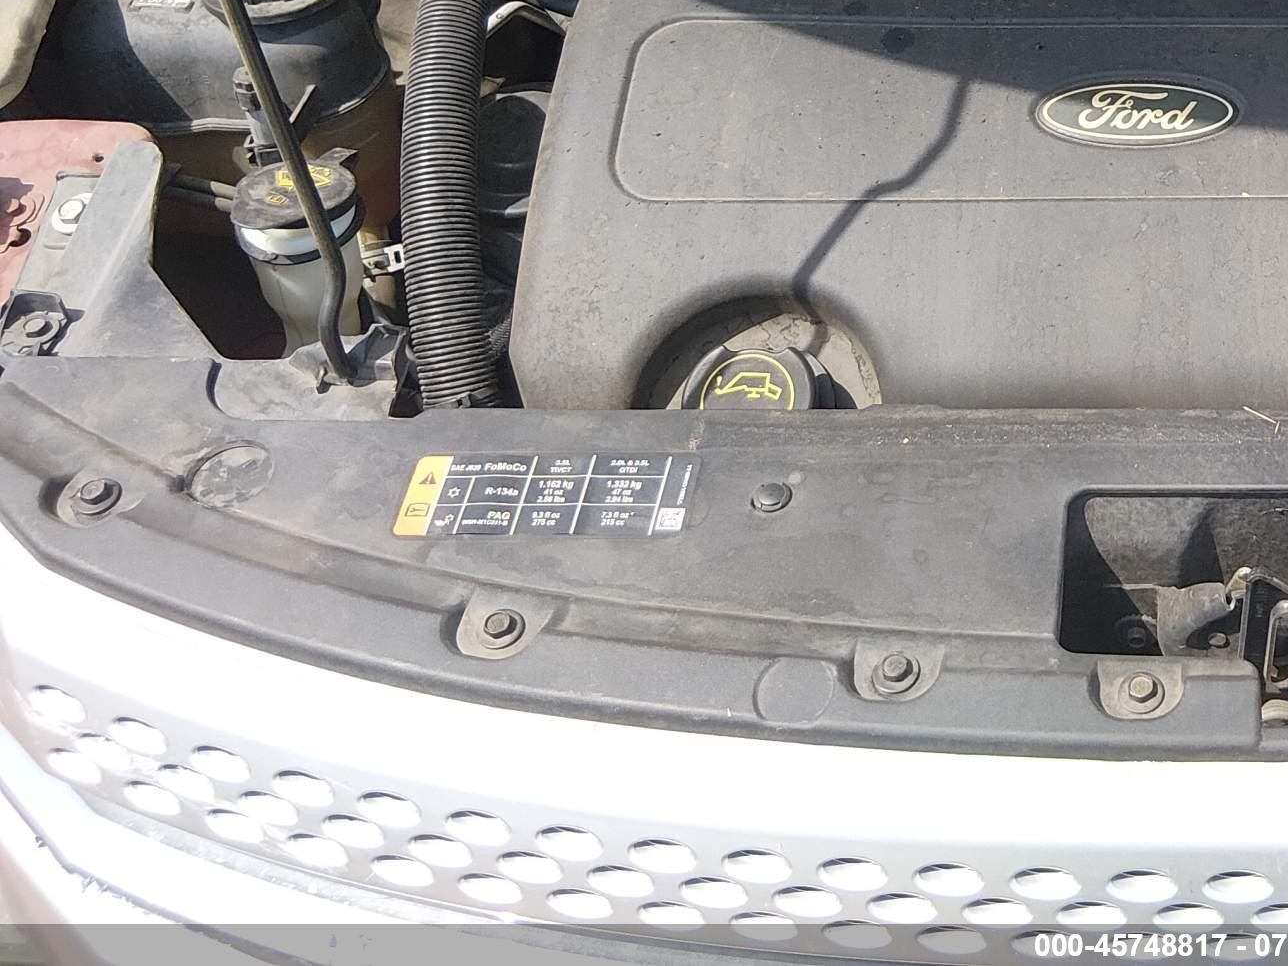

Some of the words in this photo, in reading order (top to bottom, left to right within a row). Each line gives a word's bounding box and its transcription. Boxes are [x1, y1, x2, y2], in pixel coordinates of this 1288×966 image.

[1078, 90, 1198, 130] Ford
[484, 462, 527, 472] FoMoCo
[539, 480, 561, 489] 1.162
[563, 480, 574, 490] kg
[630, 480, 643, 490] kg
[485, 487, 519, 496] R-134a
[487, 511, 511, 520] PAG
